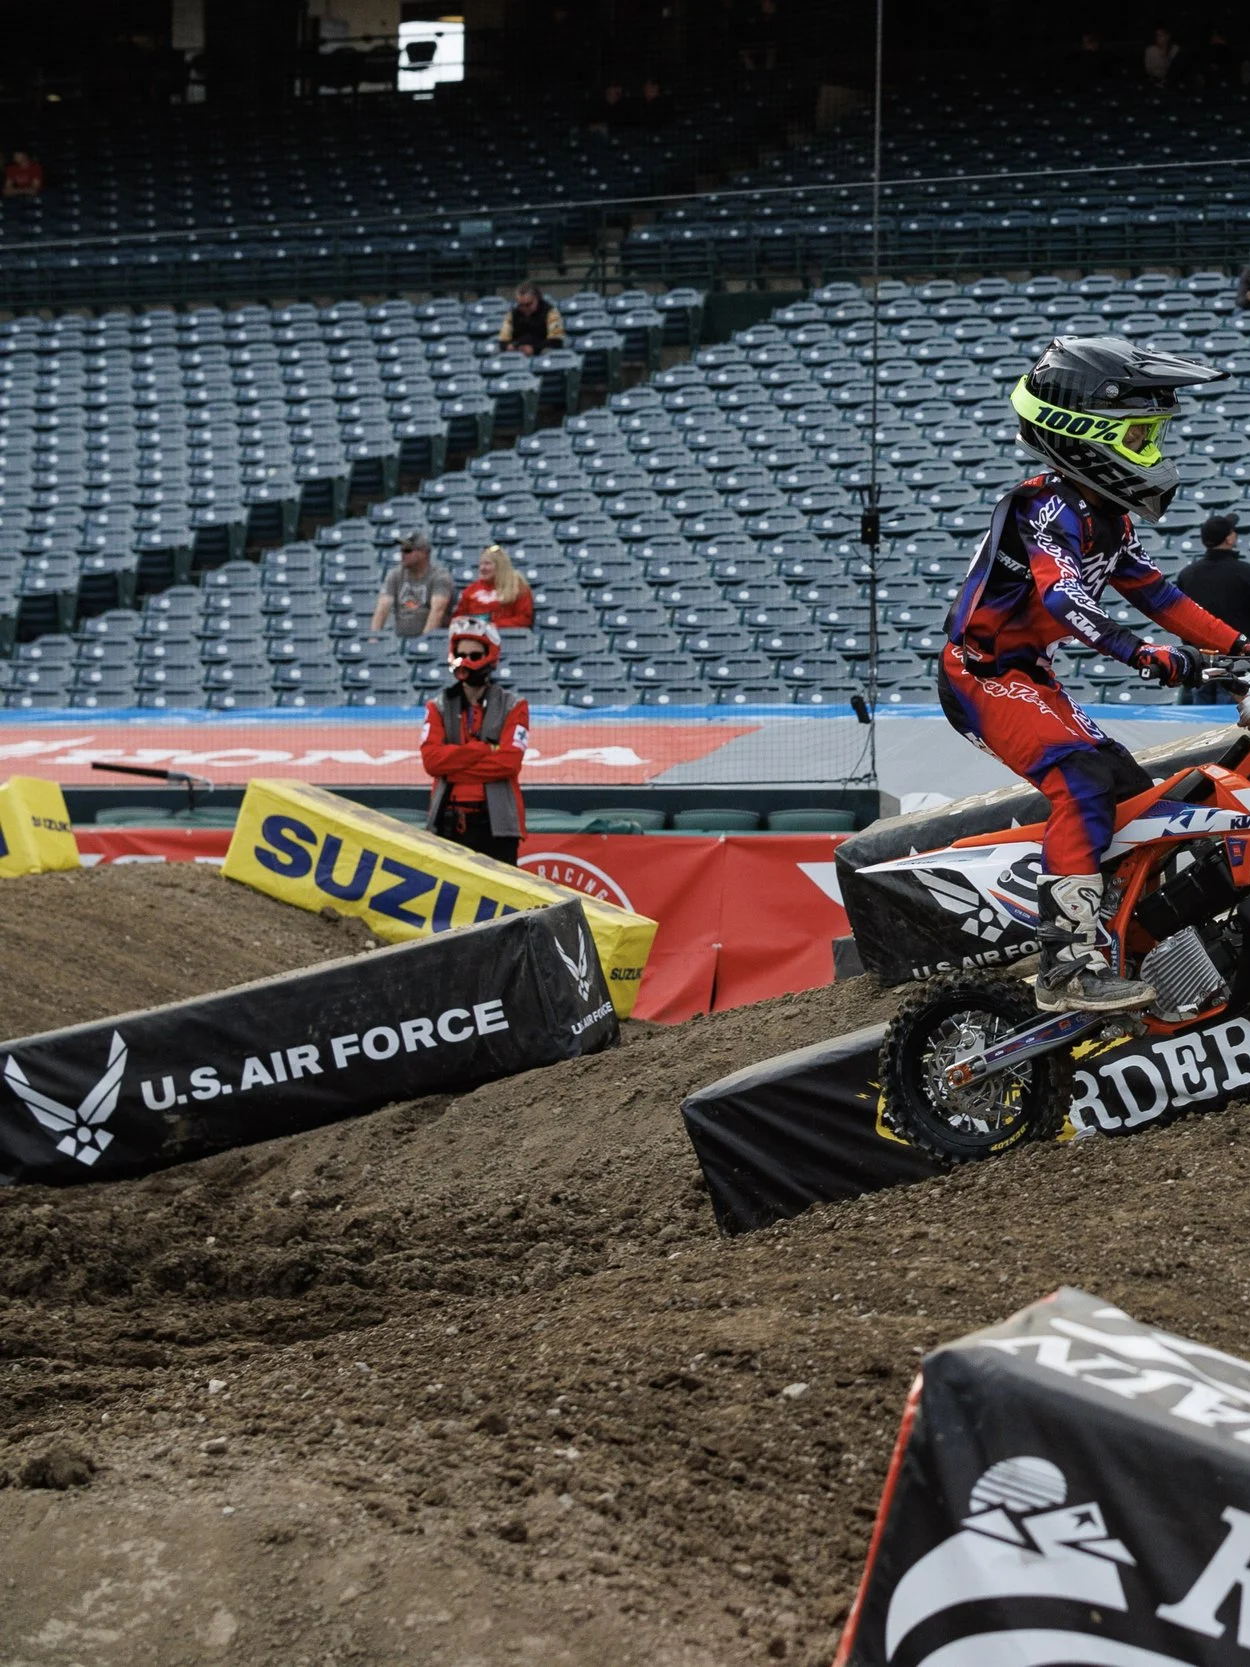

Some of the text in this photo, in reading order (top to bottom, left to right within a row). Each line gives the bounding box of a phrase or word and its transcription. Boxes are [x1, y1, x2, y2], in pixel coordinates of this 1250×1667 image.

[1034, 406, 1123, 441] 100%
[1065, 610, 1101, 642] KTM
[254, 814, 521, 934] SUZU
[537, 865, 610, 901] RACING
[962, 950, 1001, 969] AIR
[141, 999, 509, 1111] U.S. AIR FORCE
